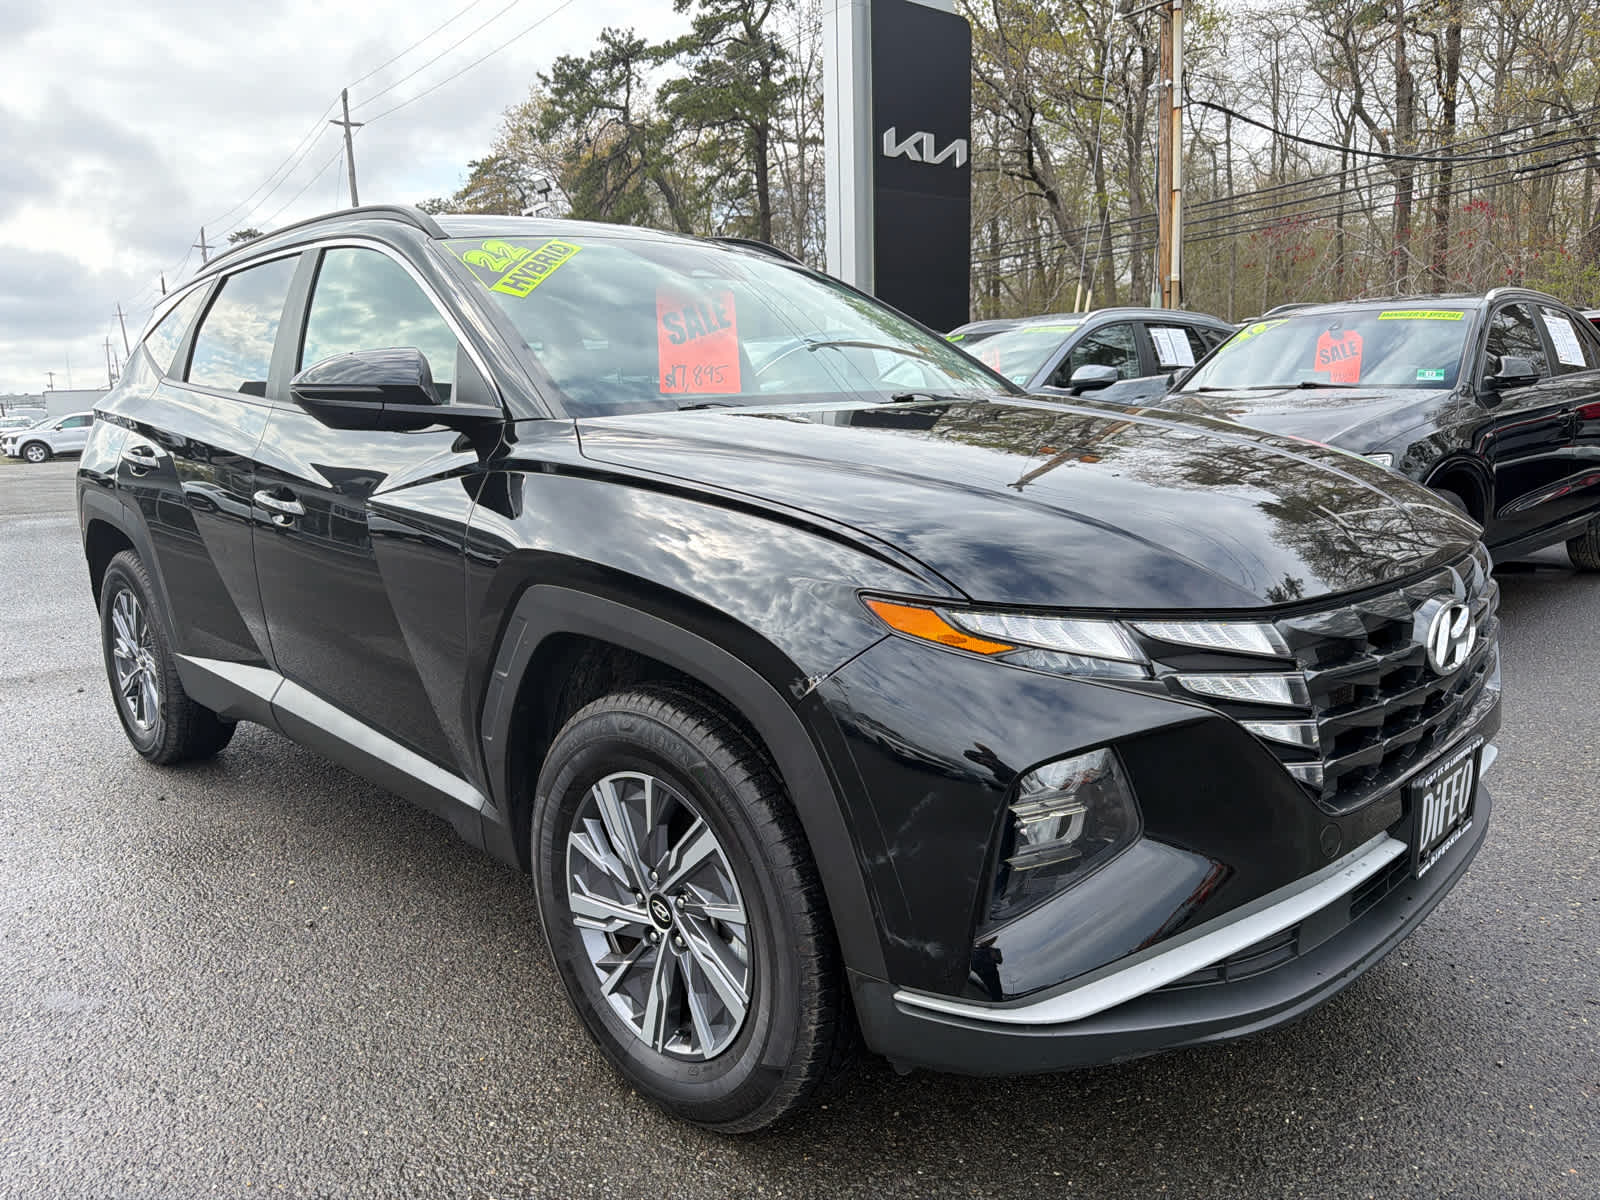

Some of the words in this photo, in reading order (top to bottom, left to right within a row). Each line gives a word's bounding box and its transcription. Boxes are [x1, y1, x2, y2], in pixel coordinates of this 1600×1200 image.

[463, 239, 533, 272] 22
[501, 243, 572, 292] HYBRID
[662, 302, 732, 346] SALE
[1319, 341, 1360, 366] SALE
[664, 363, 729, 393] $17,895
[1419, 757, 1474, 853] DiFEO
